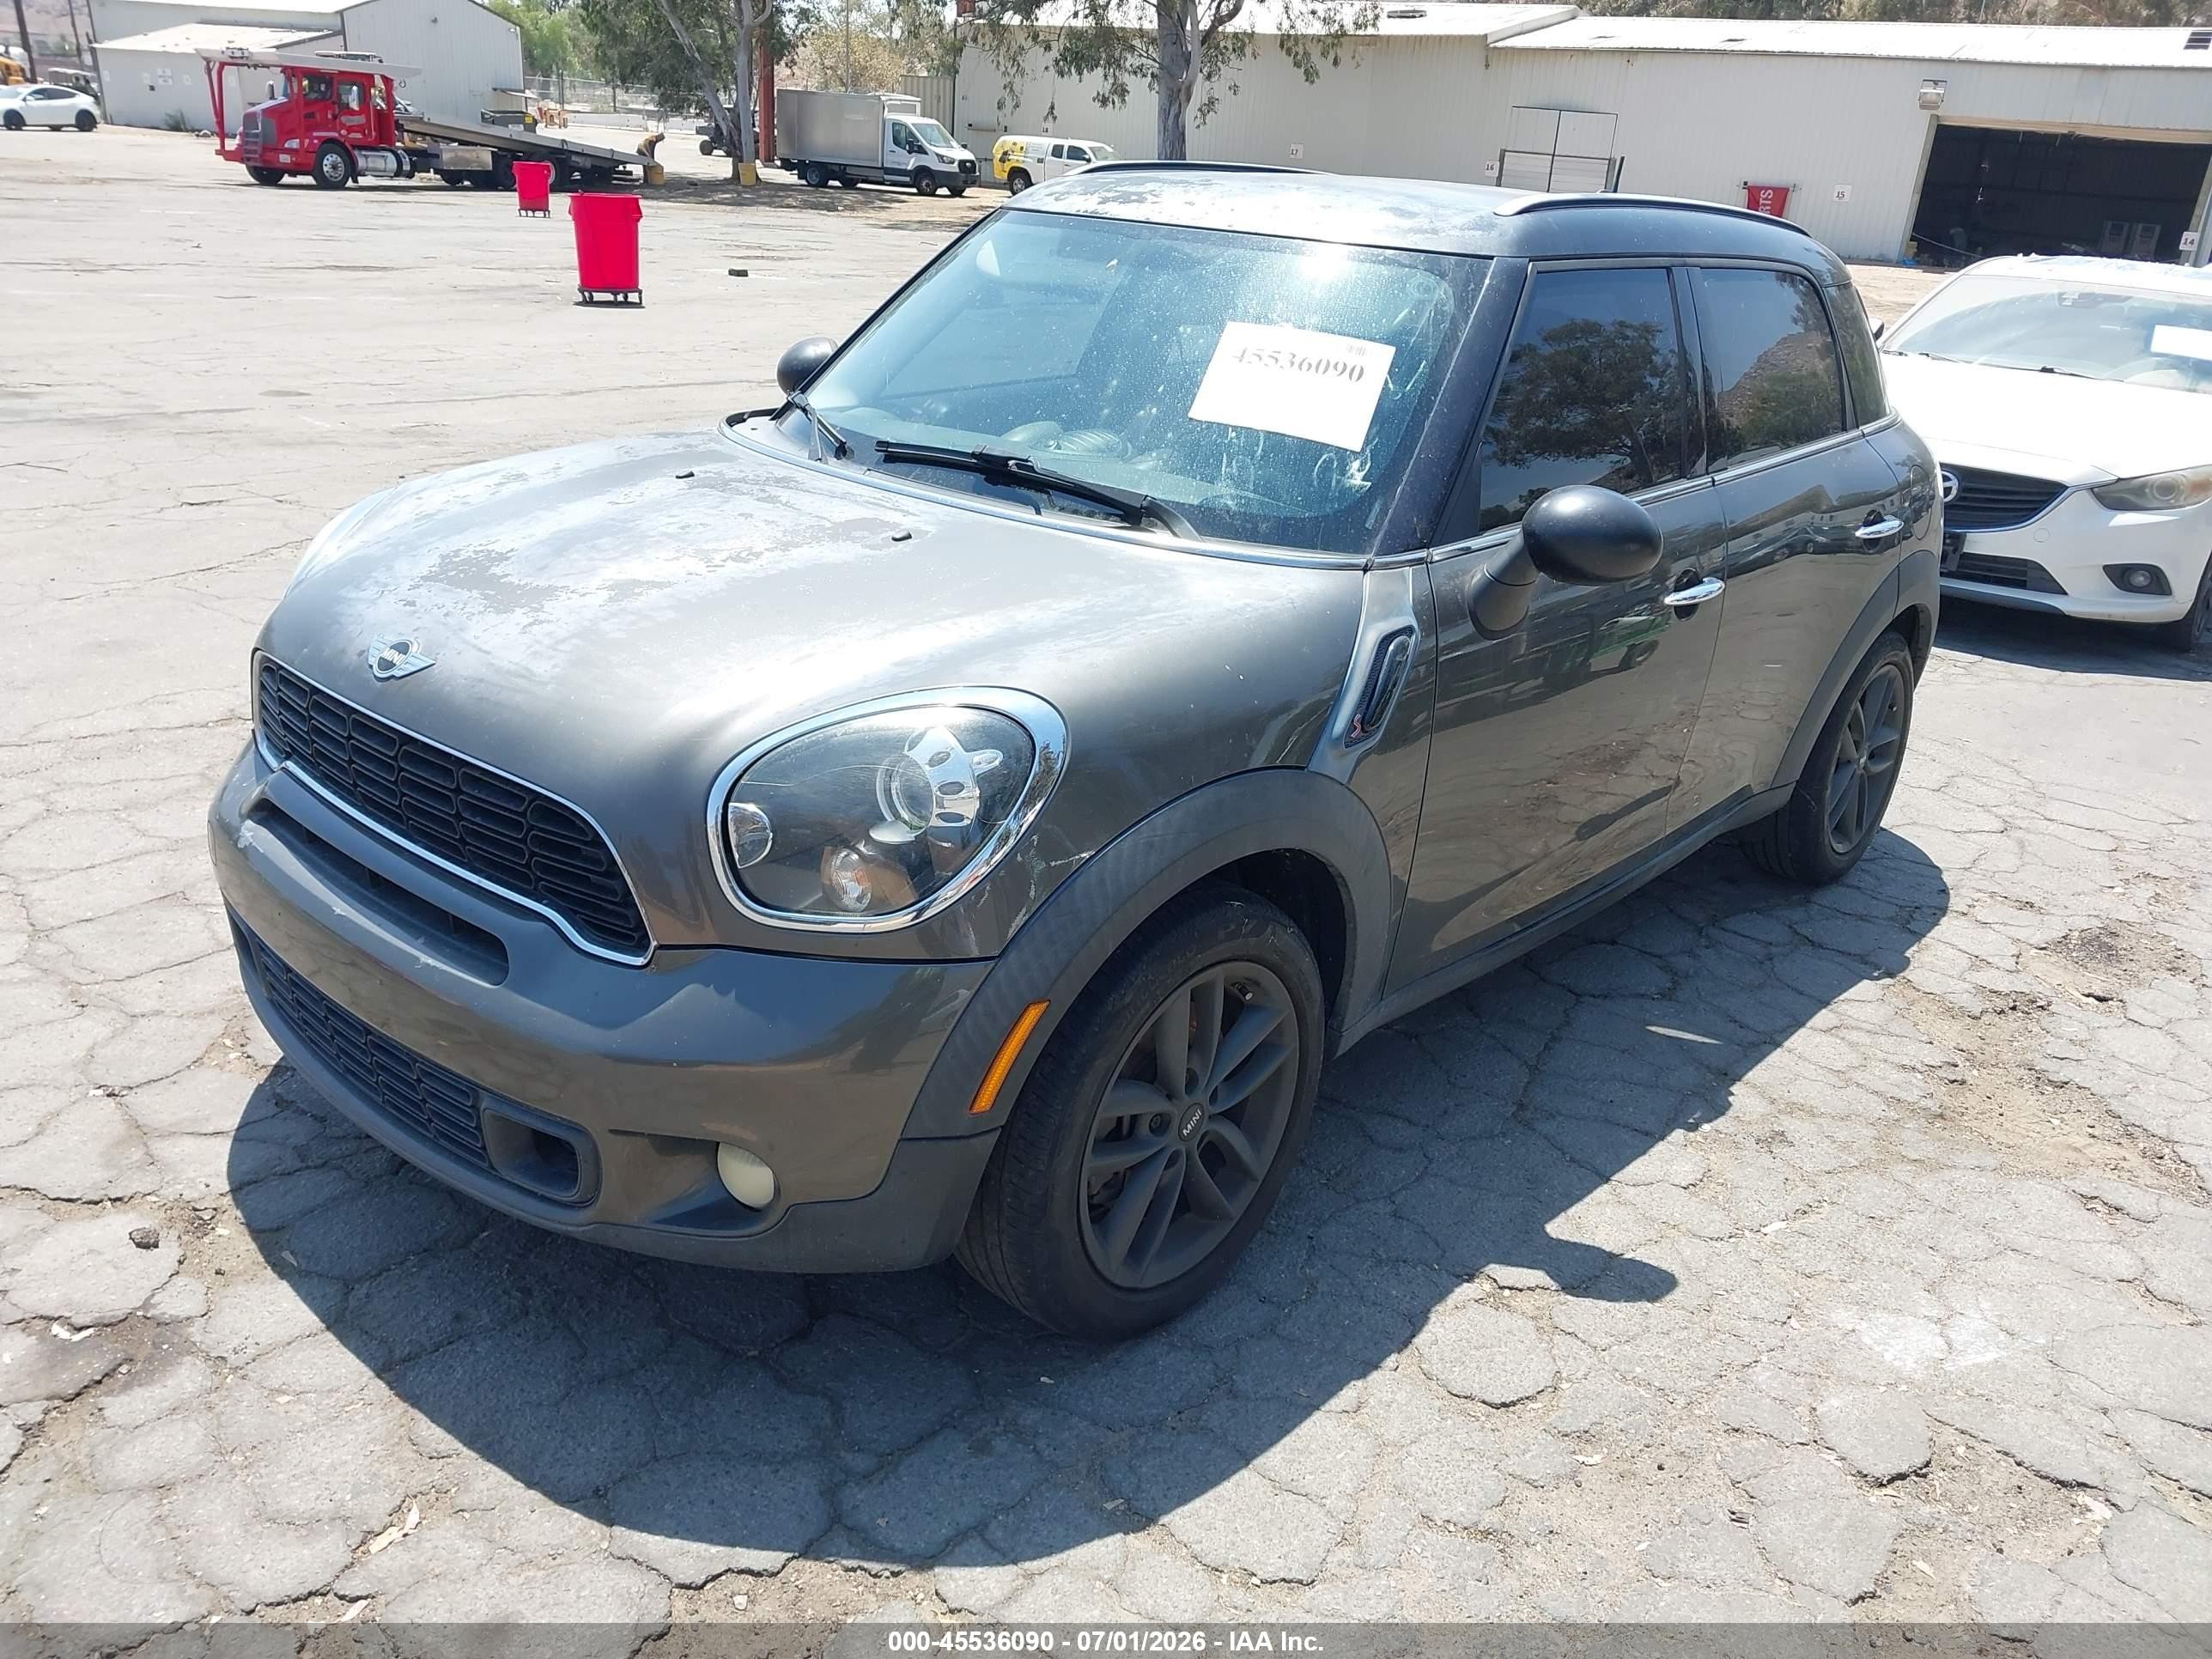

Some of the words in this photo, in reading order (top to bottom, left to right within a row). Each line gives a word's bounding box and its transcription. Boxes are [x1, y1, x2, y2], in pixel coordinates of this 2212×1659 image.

[1758, 189, 1773, 214] RTS
[2182, 237, 2195, 246] 14
[1231, 346, 1365, 383] 45536090
[380, 647, 406, 665] MINI
[1182, 1109, 1201, 1136] MINI
